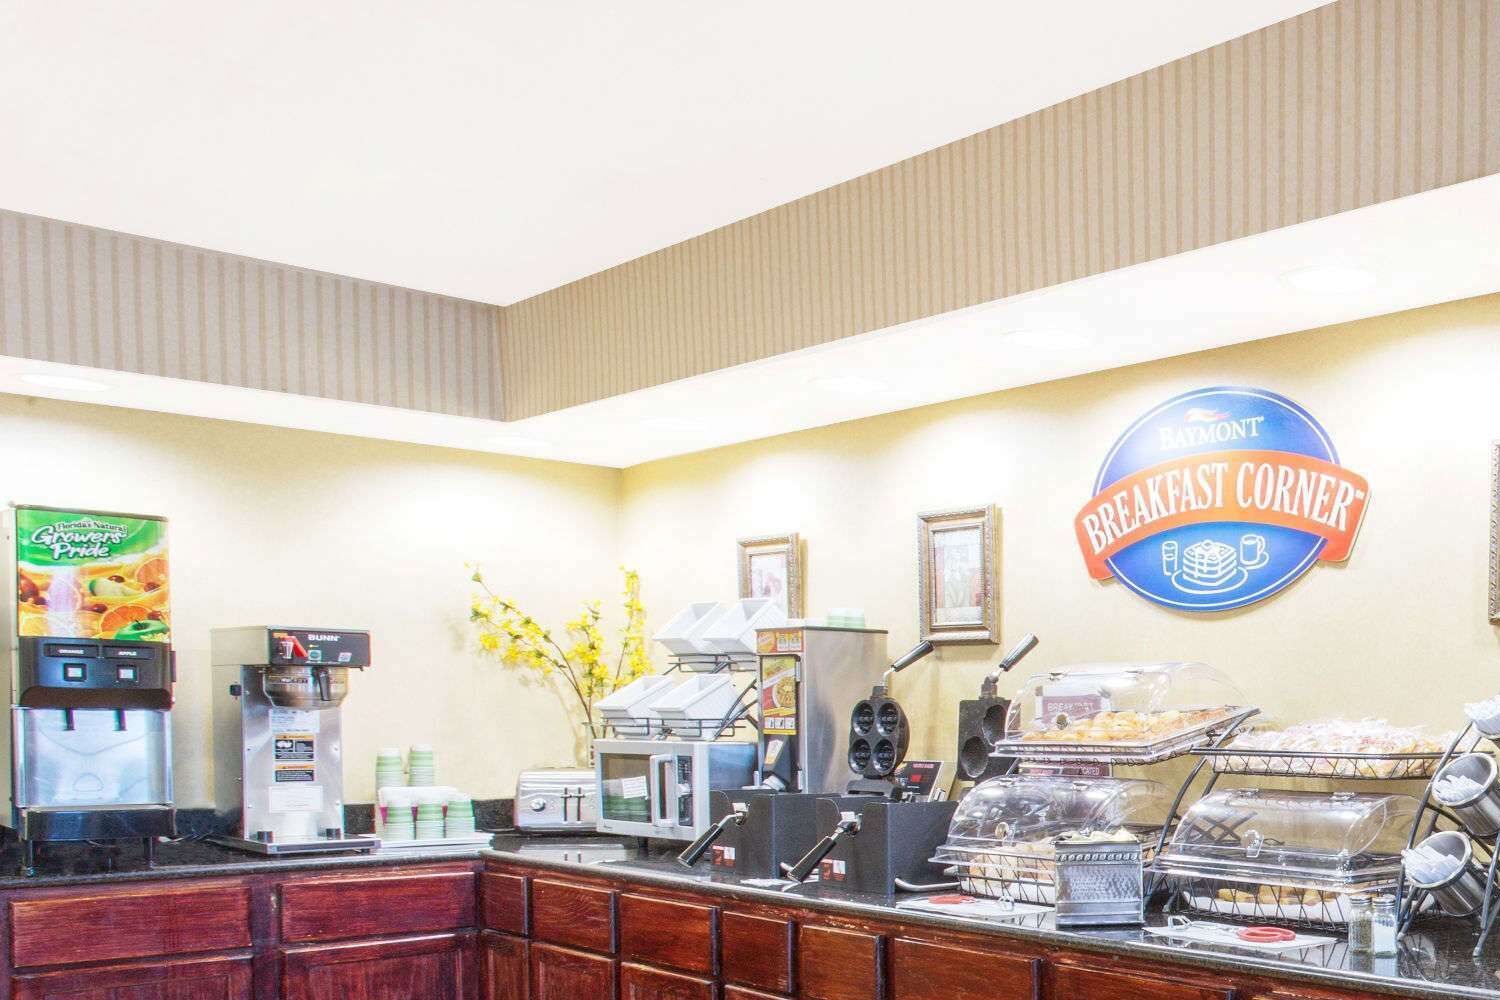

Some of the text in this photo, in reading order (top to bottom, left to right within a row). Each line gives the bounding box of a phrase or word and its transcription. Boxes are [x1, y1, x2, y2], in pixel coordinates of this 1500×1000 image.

[1159, 416, 1264, 450] BAYMONT
[1082, 461, 1348, 554] BREAKFAST CORNER
[50, 543, 110, 560] Pride
[307, 634, 338, 642] BUNN
